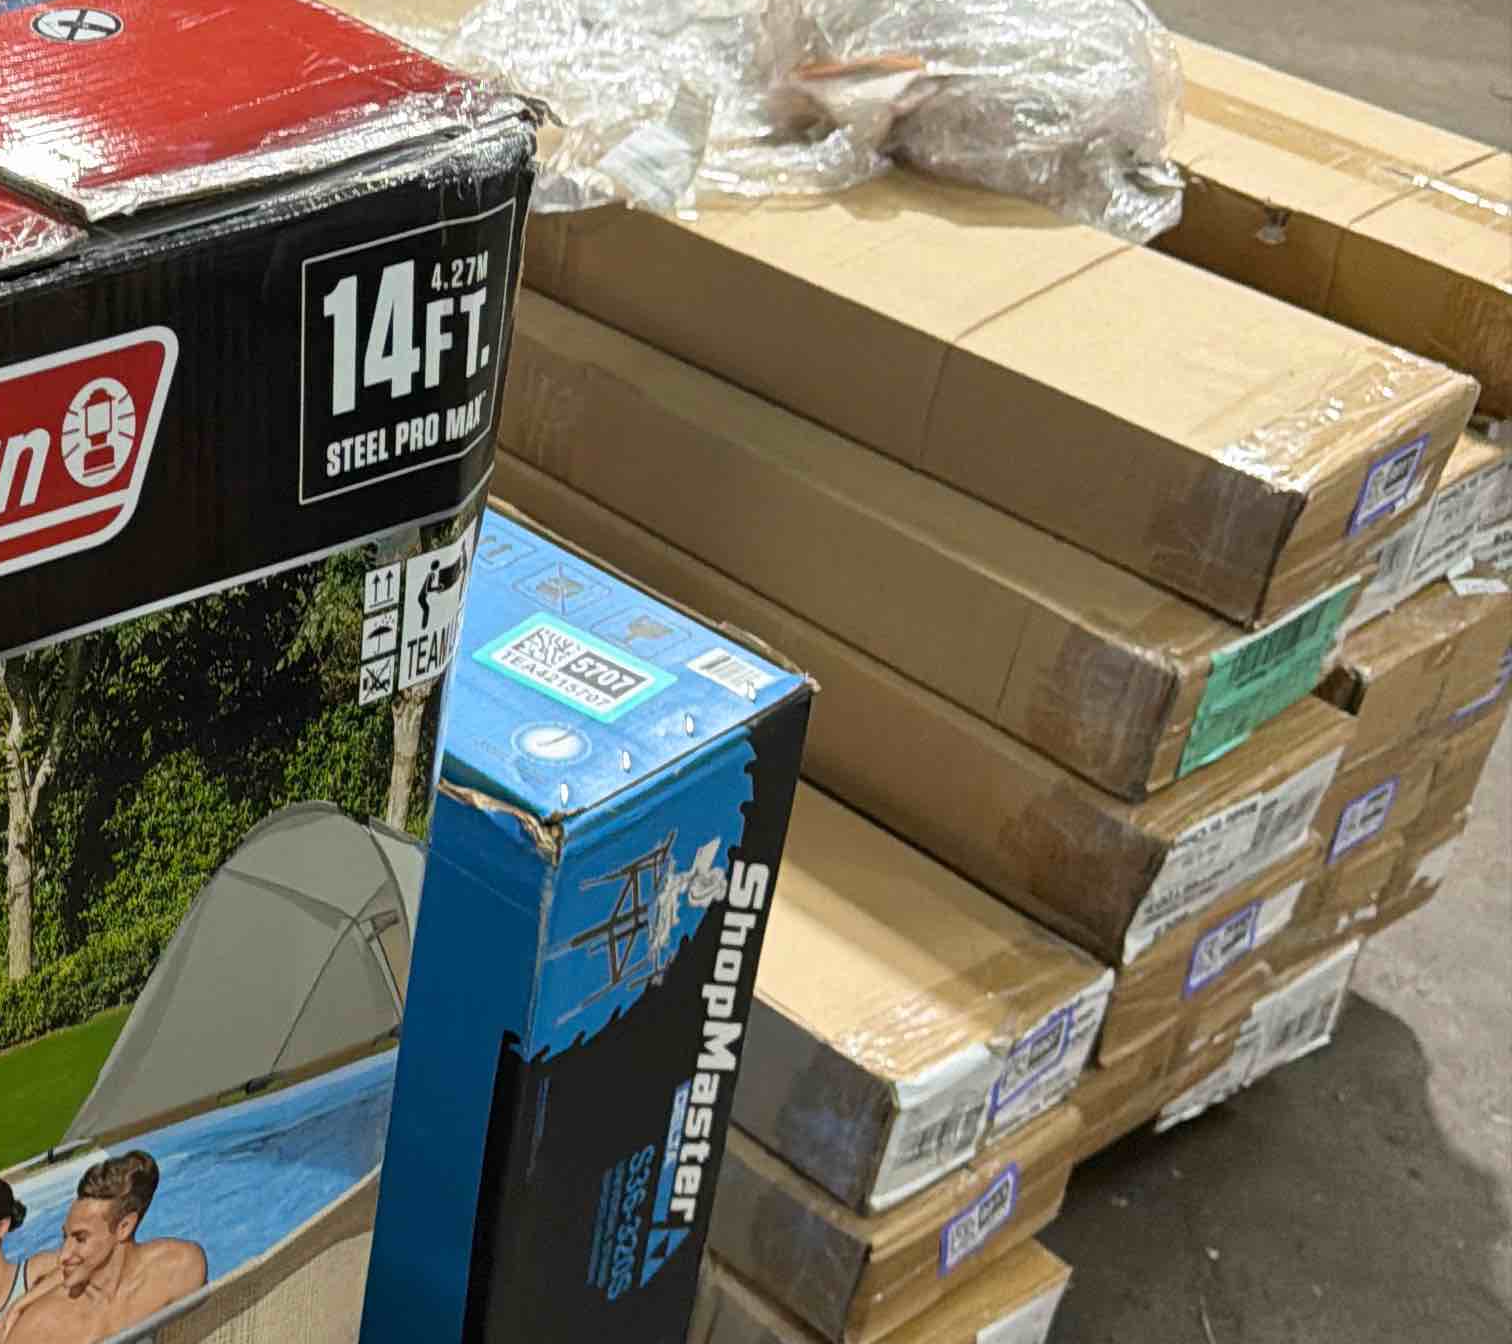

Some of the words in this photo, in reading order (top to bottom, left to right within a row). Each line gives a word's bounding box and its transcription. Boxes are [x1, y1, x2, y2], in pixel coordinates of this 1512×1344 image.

[431, 251, 489, 292] 4.27M
[323, 259, 421, 416] 14
[424, 287, 490, 390] FT.
[326, 427, 389, 478] STEEL
[395, 411, 440, 457] PRO
[446, 398, 484, 443] MAX
[500, 649, 614, 709] TEA4215707
[567, 654, 640, 696] 5707
[669, 859, 770, 1224] ShopMaster
